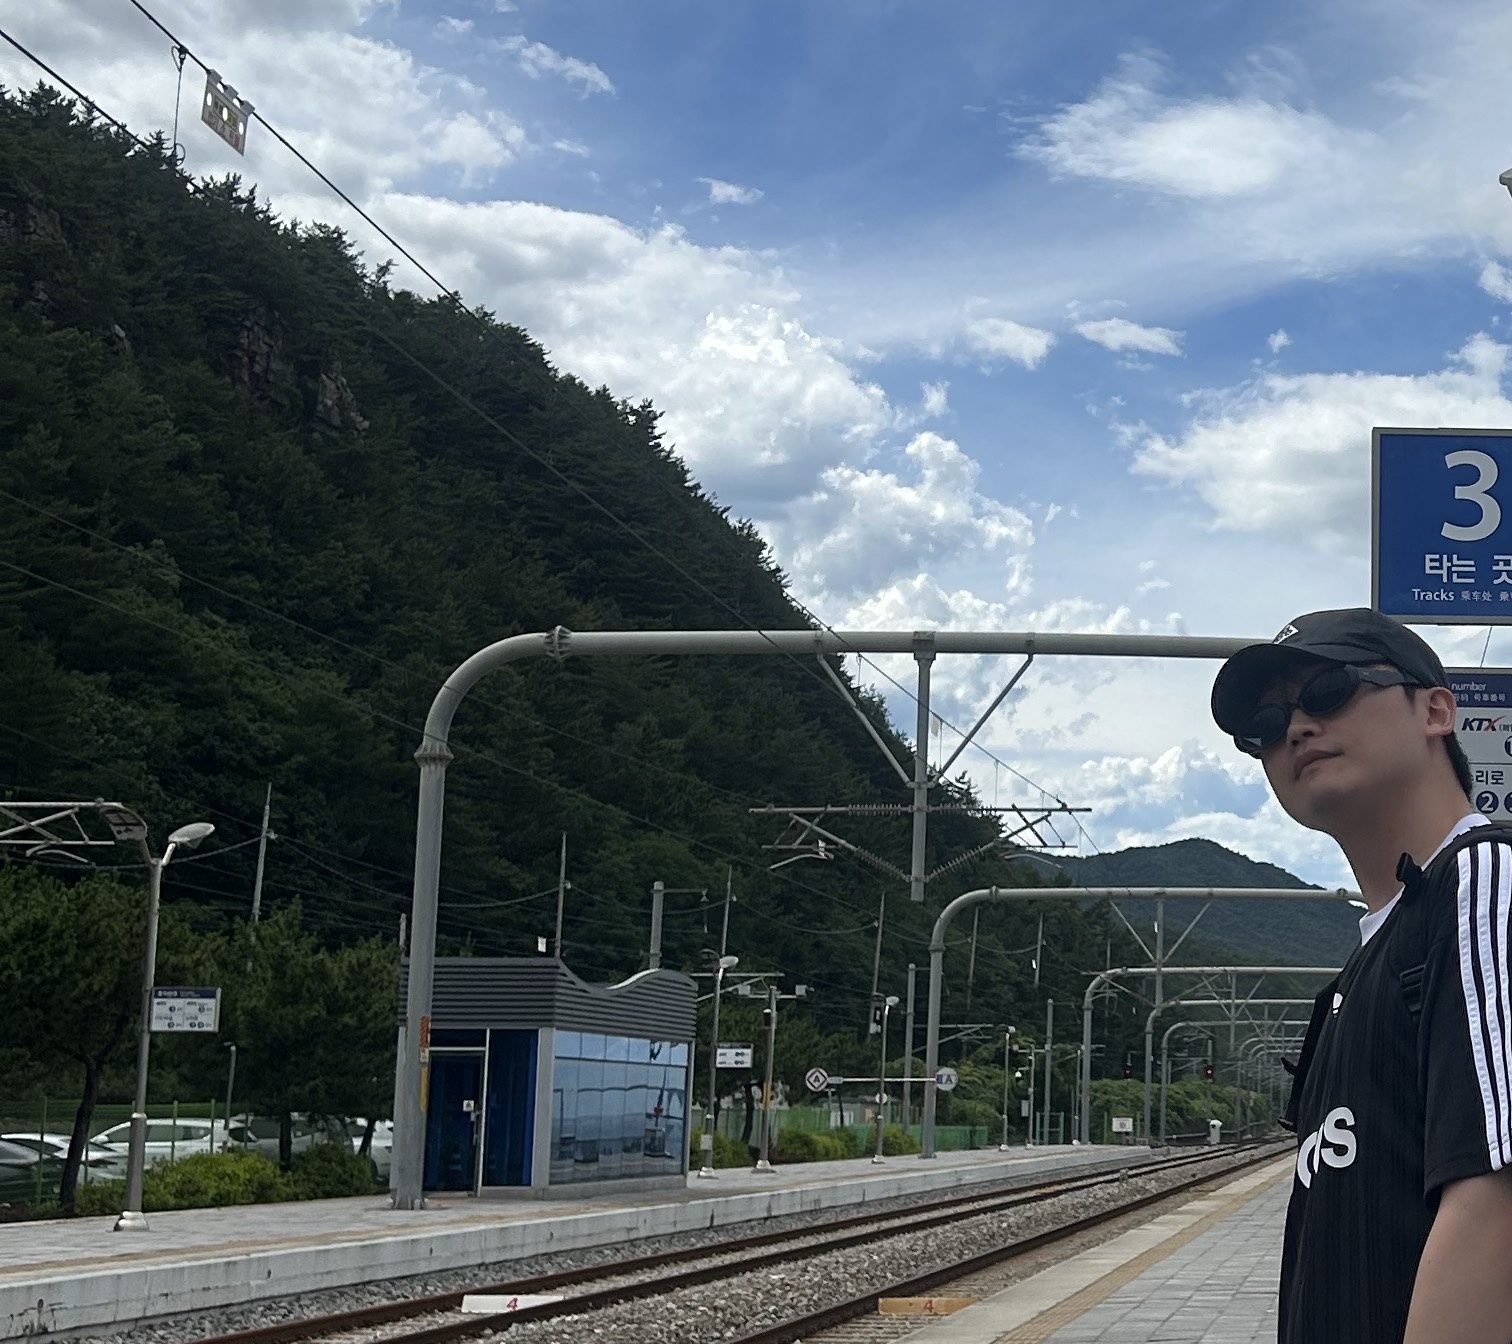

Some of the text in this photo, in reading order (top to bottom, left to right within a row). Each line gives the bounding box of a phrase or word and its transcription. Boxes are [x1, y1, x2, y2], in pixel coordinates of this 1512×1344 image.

[1440, 449, 1502, 542] 3
[1424, 553, 1476, 584] 타는
[1411, 588, 1455, 601] Tracks
[1451, 681, 1487, 691] number
[1462, 716, 1505, 732] KTX
[1475, 770, 1505, 785] 리로
[1480, 792, 1495, 812] 2
[506, 1297, 518, 1311] 4
[923, 1299, 935, 1313] 4
